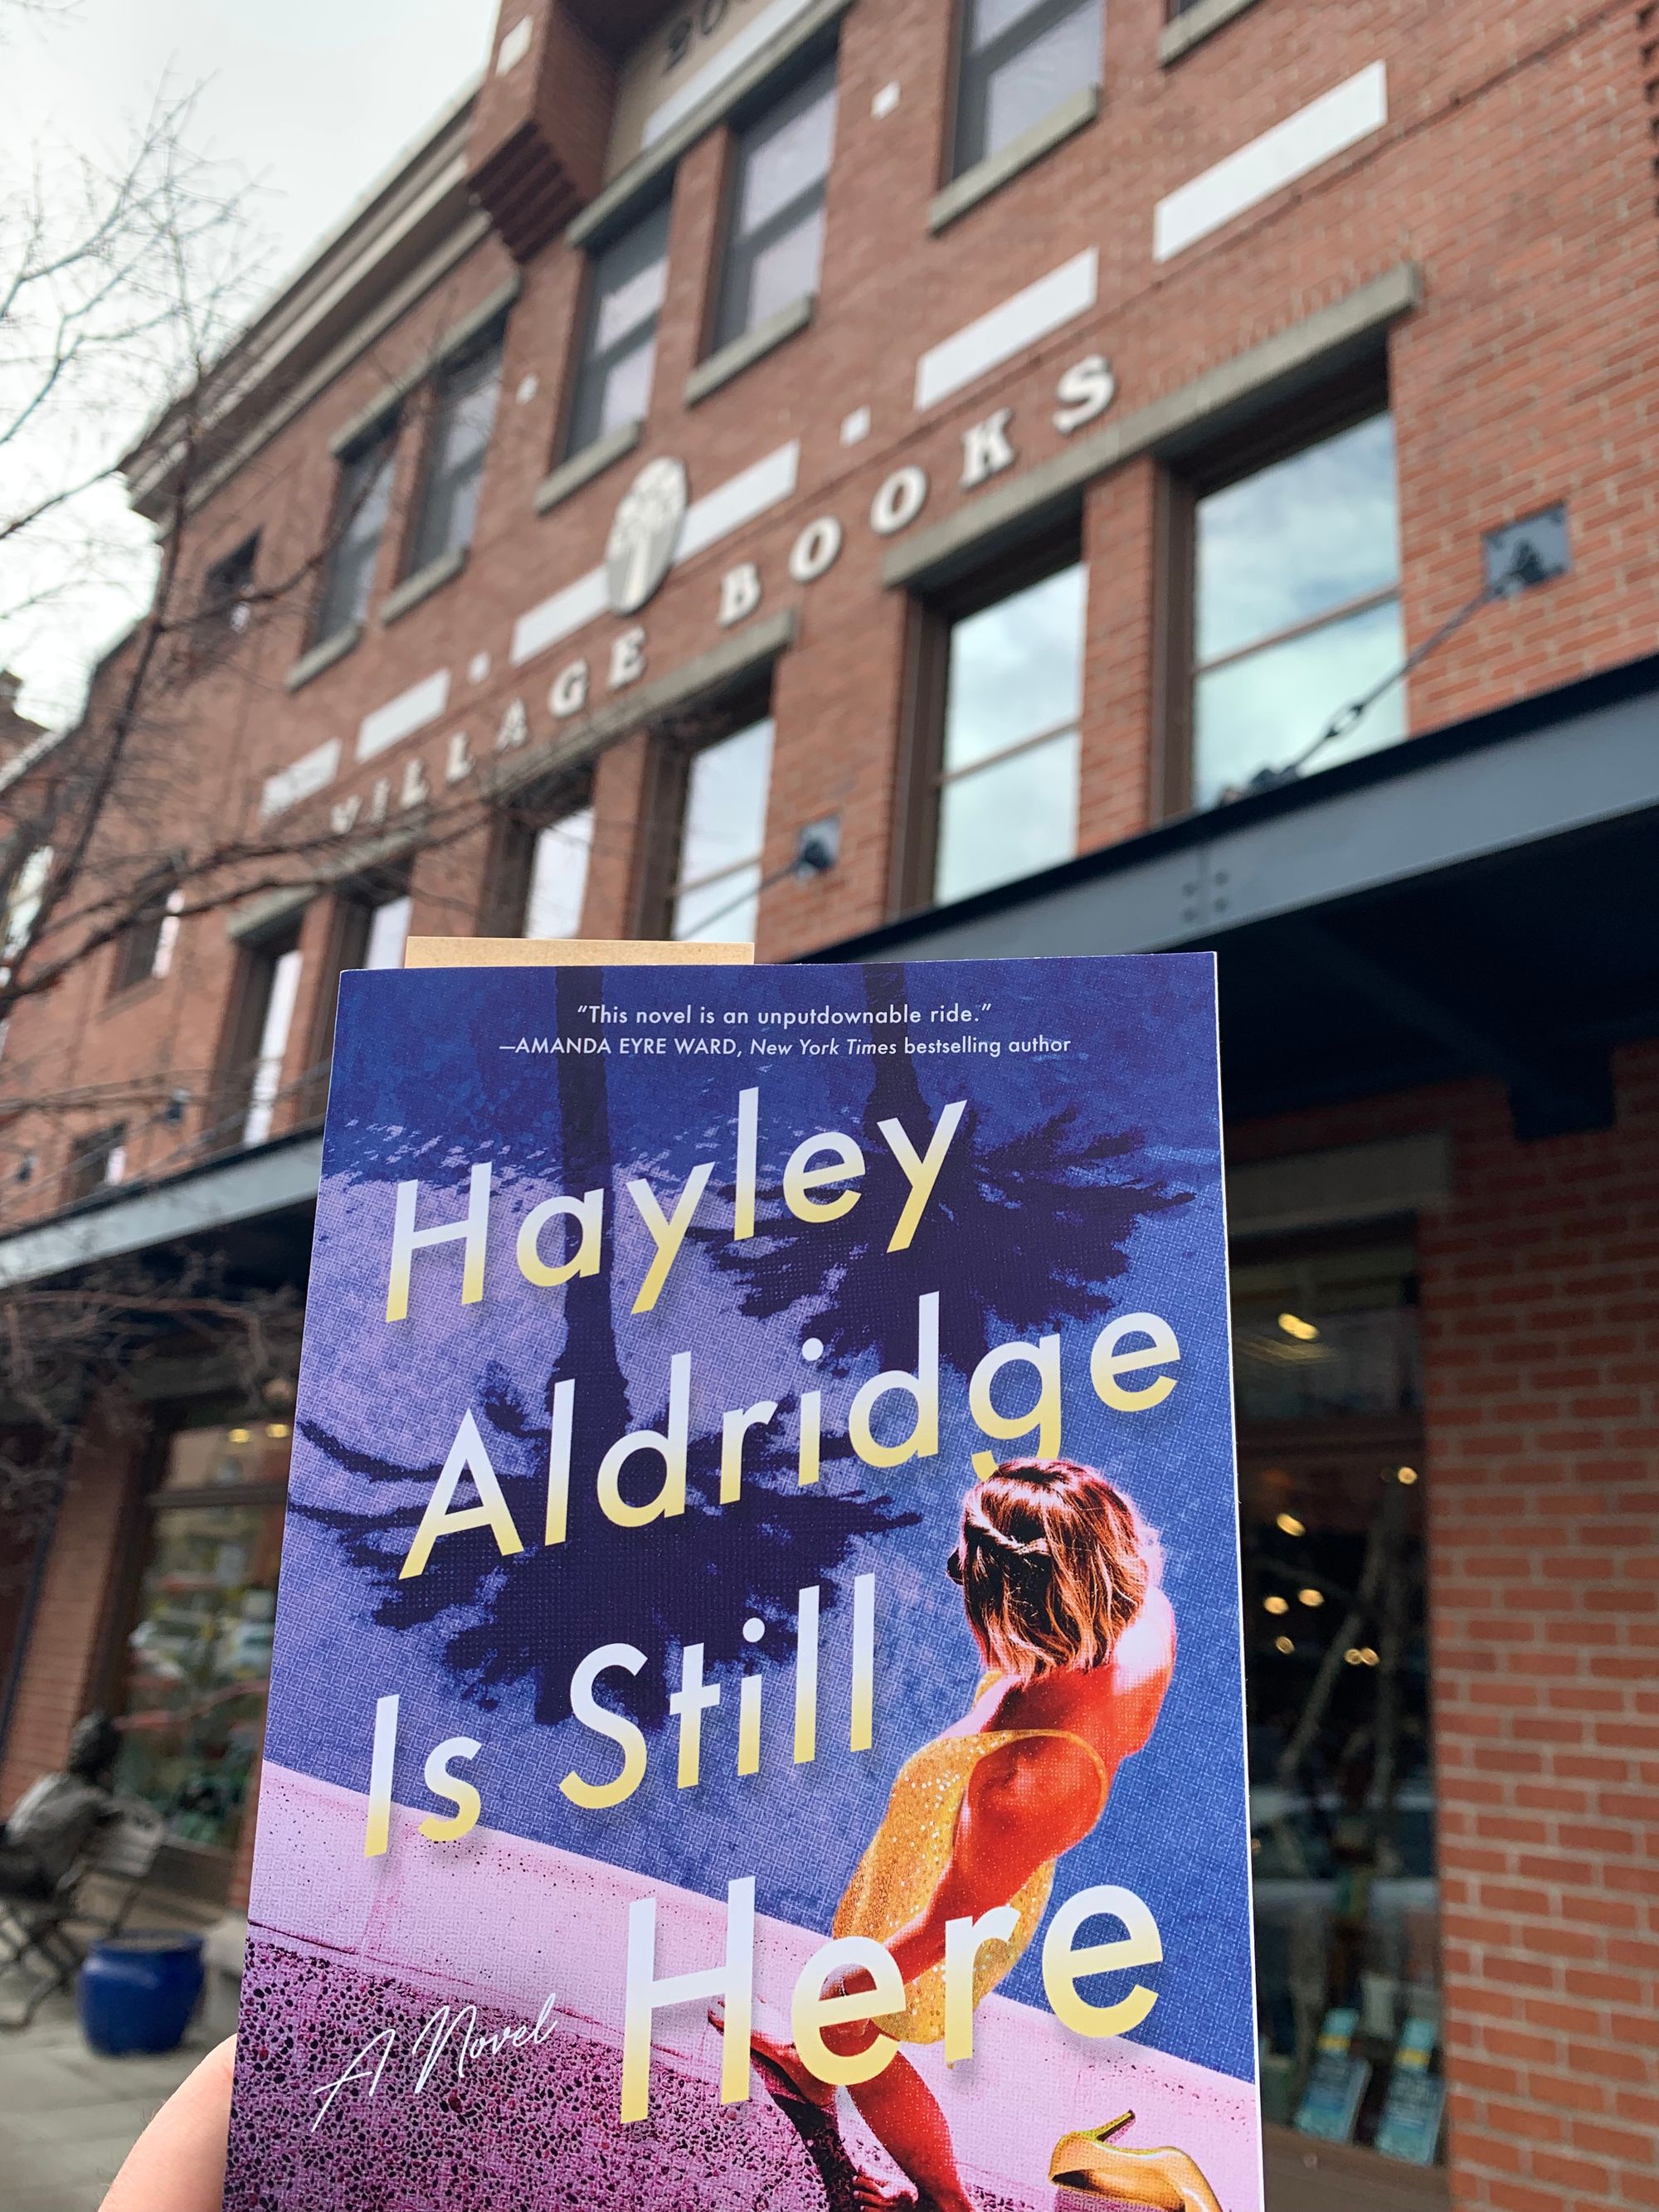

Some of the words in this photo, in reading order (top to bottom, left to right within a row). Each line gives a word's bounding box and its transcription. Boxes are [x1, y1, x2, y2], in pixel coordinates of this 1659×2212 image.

[331, 625, 647, 834] VILLAGE
[720, 354, 1117, 626] BOOKS
[620, 1038, 666, 1055] EYRE
[674, 1038, 742, 1058] WARD,
[750, 1038, 793, 1056] New
[799, 1038, 839, 1056] York
[846, 1038, 898, 1056] Times
[904, 1035, 1001, 1057] bestselling
[1009, 1034, 1071, 1053] author
[635, 1005, 692, 1025] novel
[700, 1007, 715, 1024] is
[722, 1010, 748, 1024] an
[757, 1004, 922, 1029] unputdownable
[386, 1087, 967, 1322] Hayley
[399, 1292, 1181, 1580] Aldridge
[363, 1694, 484, 1858] Is
[558, 1573, 876, 1810] Still
[311, 2029, 397, 2133] A
[411, 1992, 558, 2094] Novel
[620, 1876, 1163, 2124] Here
